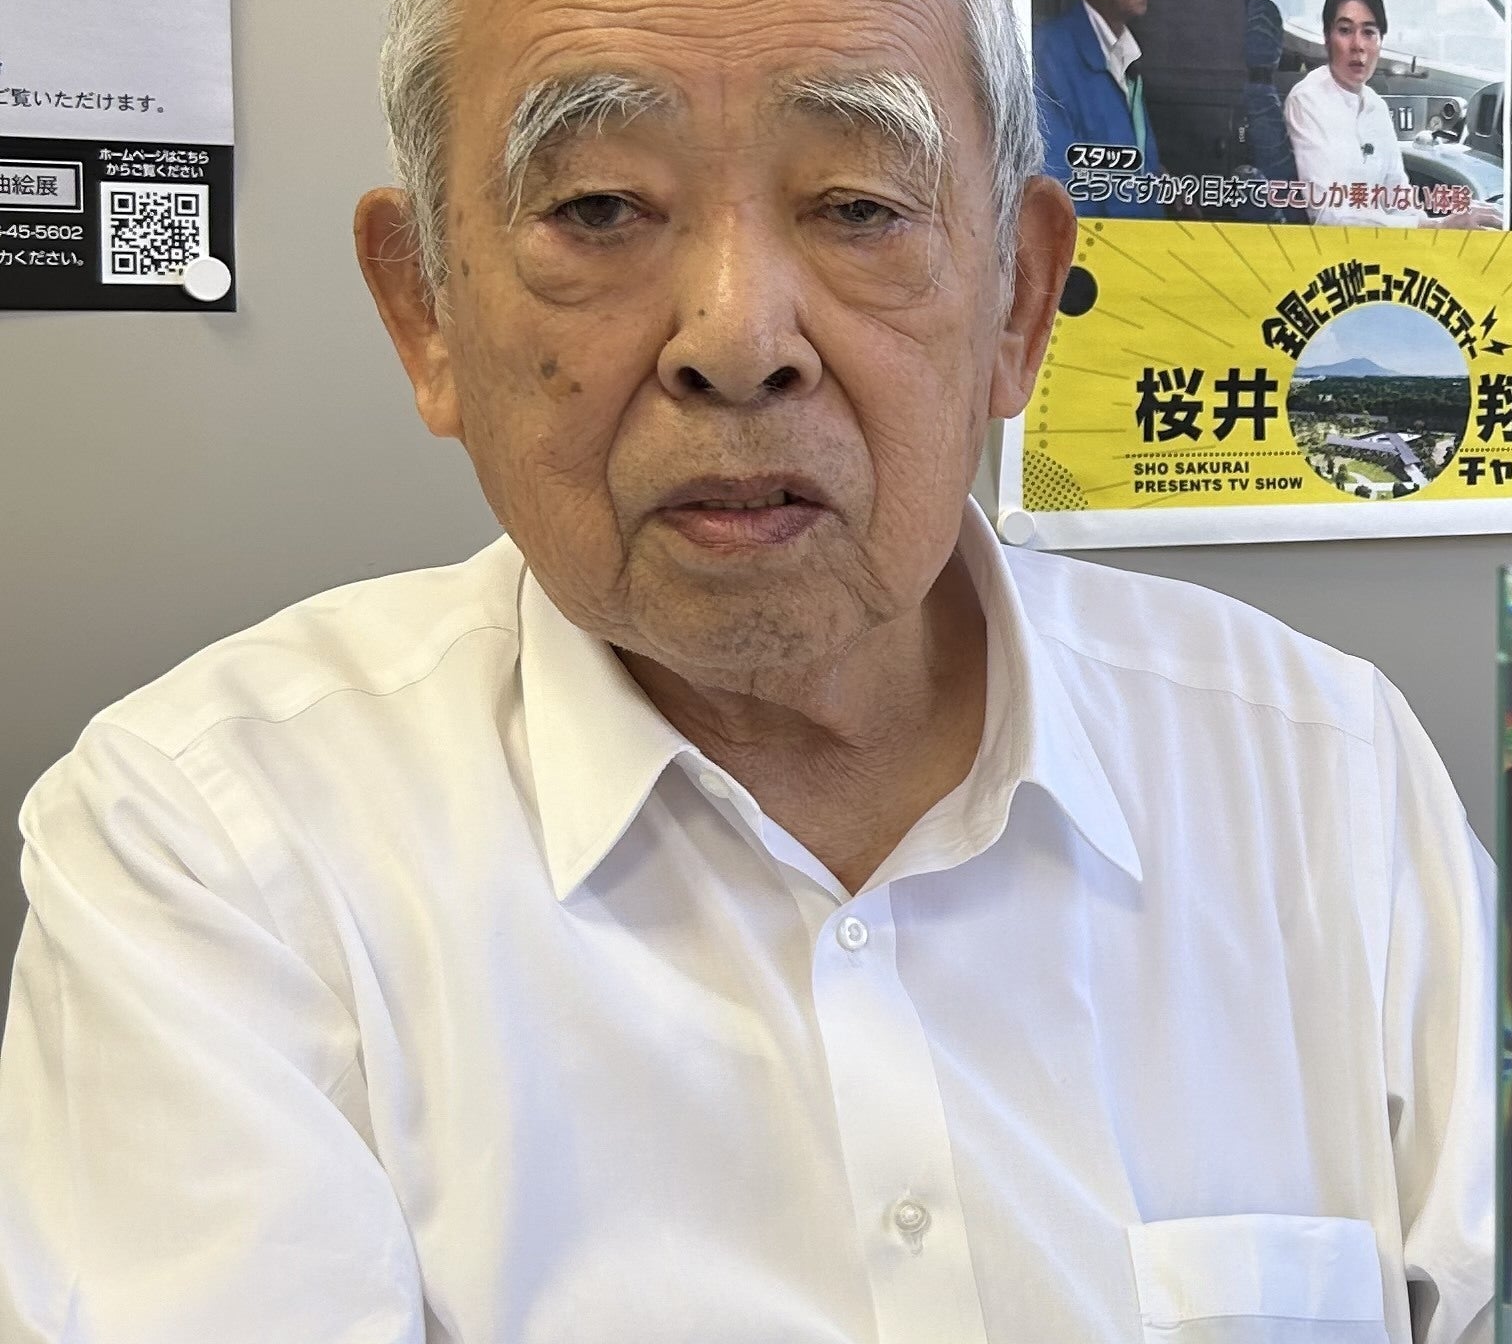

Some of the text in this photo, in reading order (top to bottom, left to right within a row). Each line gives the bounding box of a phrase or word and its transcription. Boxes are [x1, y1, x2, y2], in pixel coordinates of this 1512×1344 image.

[99, 149, 209, 164] ホームページはこちら
[1073, 147, 1136, 168] スタッフ
[106, 163, 204, 178] からご覧ください
[1261, 259, 1477, 360] 全国ご当地ニュースバラエティー
[1135, 367, 1278, 442] 桜井
[1133, 460, 1250, 476] SHO SAKURAI
[1133, 476, 1303, 493] PRESENTS TV SHOW
